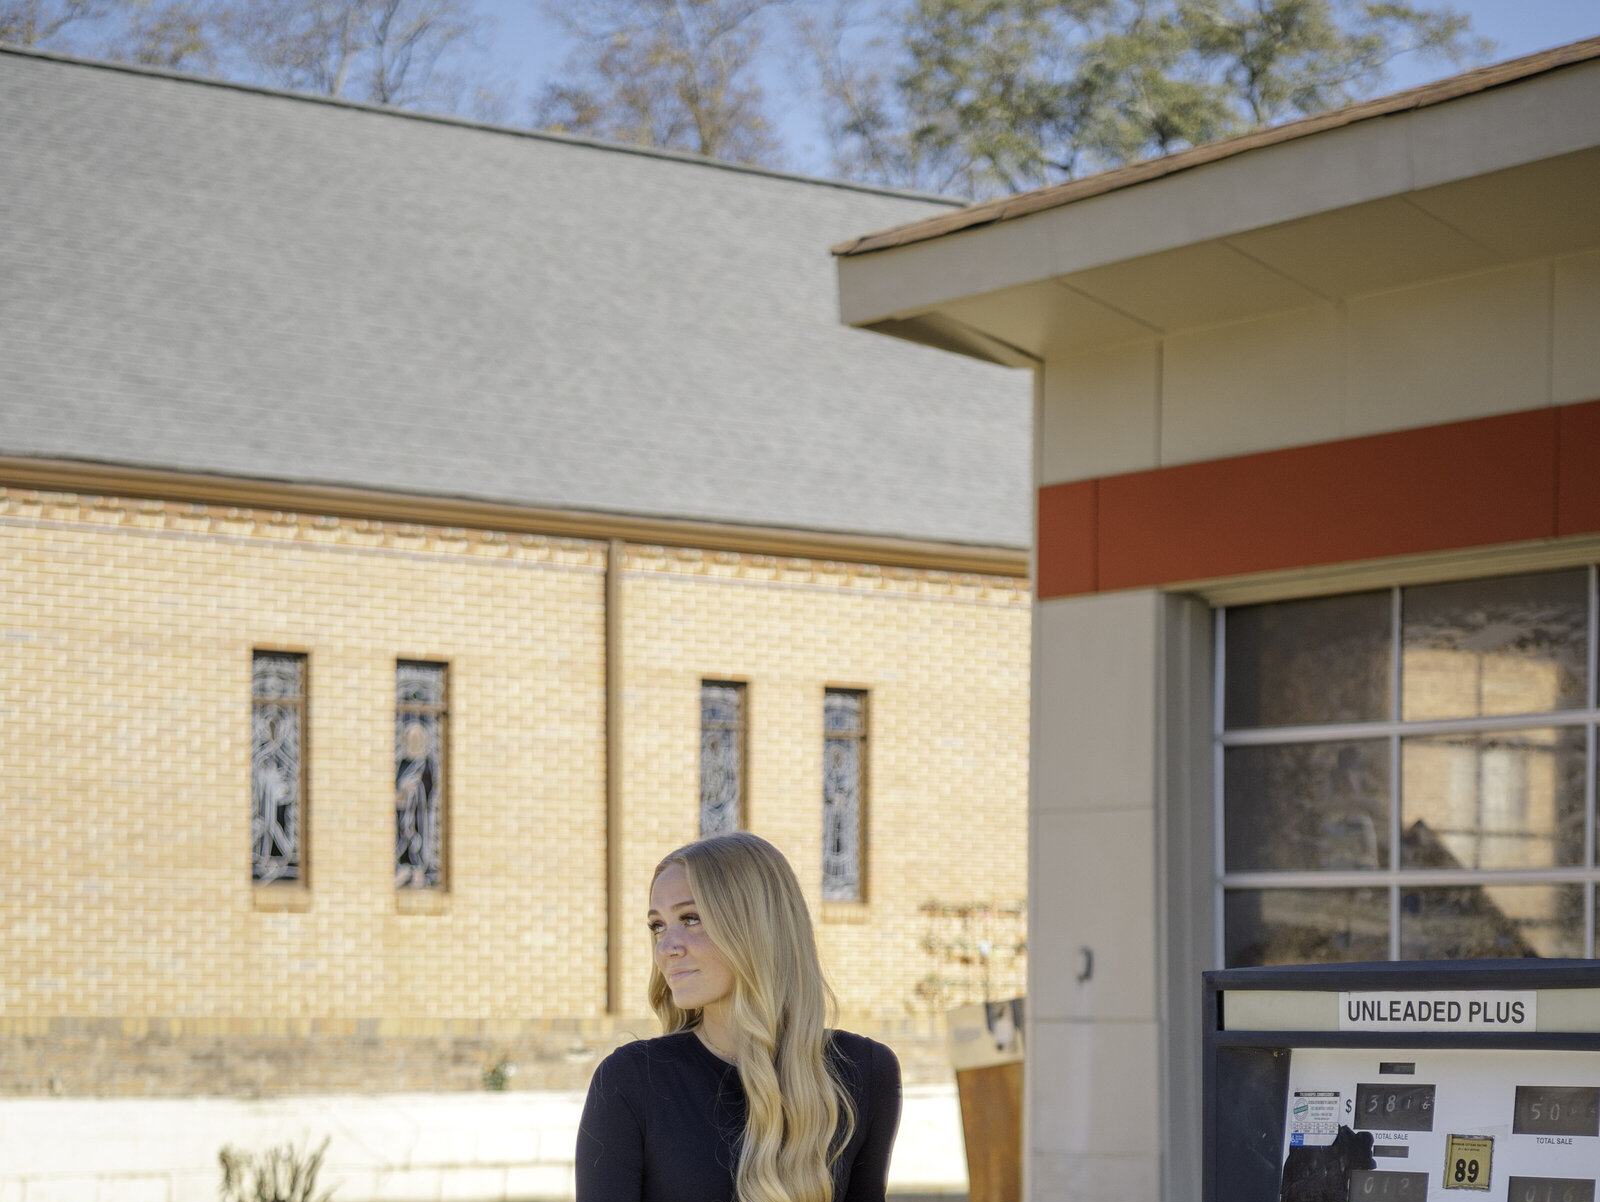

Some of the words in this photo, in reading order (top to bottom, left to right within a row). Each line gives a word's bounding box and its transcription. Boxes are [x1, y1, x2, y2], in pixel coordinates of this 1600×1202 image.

[1348, 1000, 1461, 1022] UNLEADED
[1469, 1001, 1525, 1024] PLUS
[1345, 1098, 1353, 1114] $
[1394, 1133, 1409, 1141] SALE
[1536, 1137, 1555, 1145] TOTAL
[1455, 1158, 1480, 1183] 89
